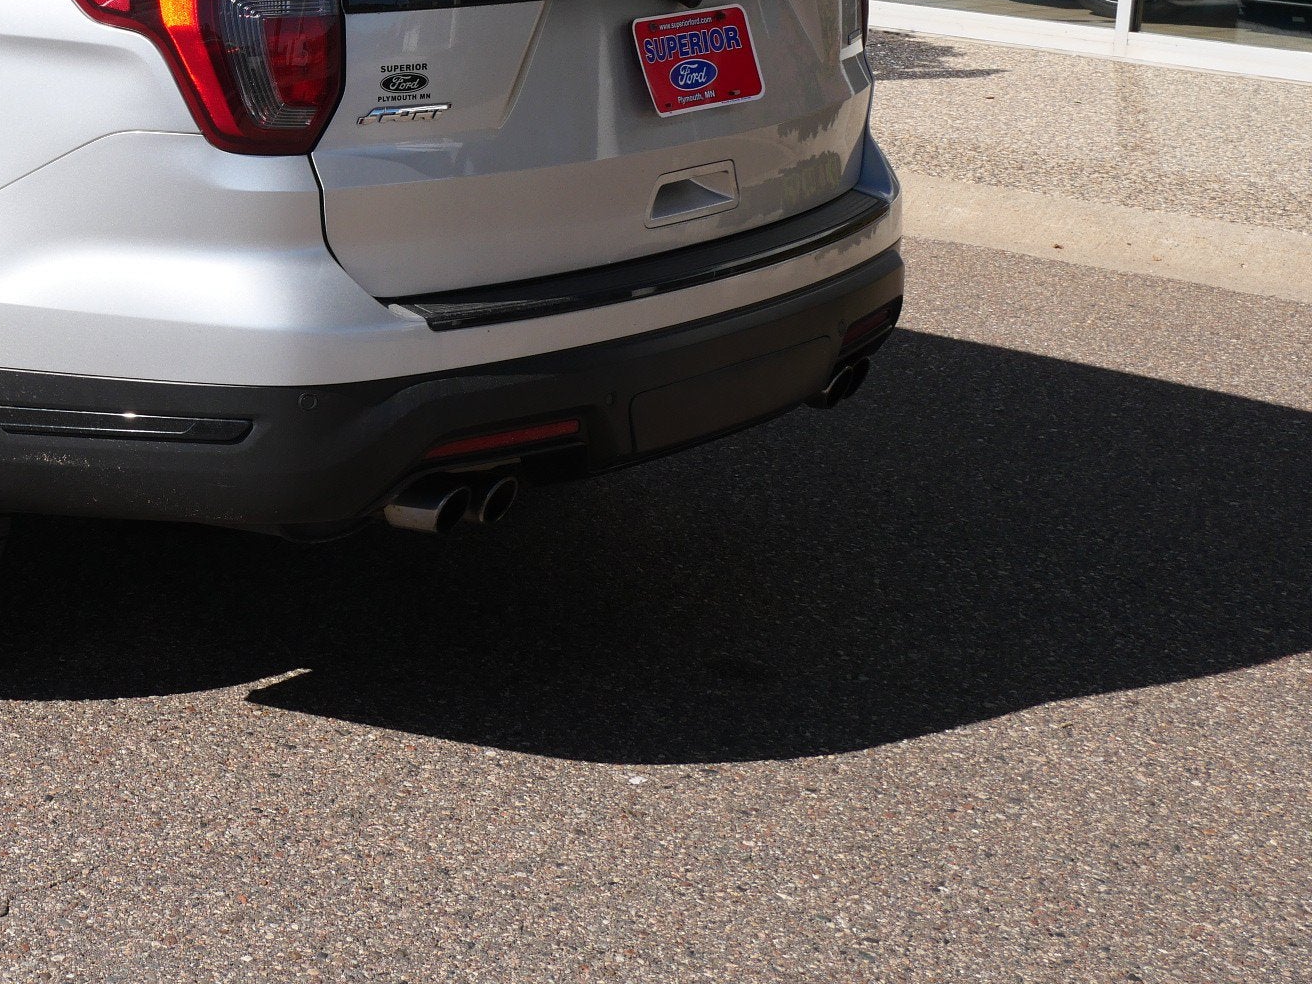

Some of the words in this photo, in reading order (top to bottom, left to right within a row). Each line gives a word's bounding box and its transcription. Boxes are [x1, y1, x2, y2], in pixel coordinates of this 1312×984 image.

[659, 17, 713, 30] www.superiorford.com
[644, 25, 742, 63] SUPERIOR
[380, 63, 428, 73] SUPERIOR
[678, 64, 707, 86] Ford
[389, 75, 419, 90] Ford
[377, 94, 417, 103] PLYMOUTH
[677, 93, 704, 104] Plymouth,
[704, 89, 716, 98] MN
